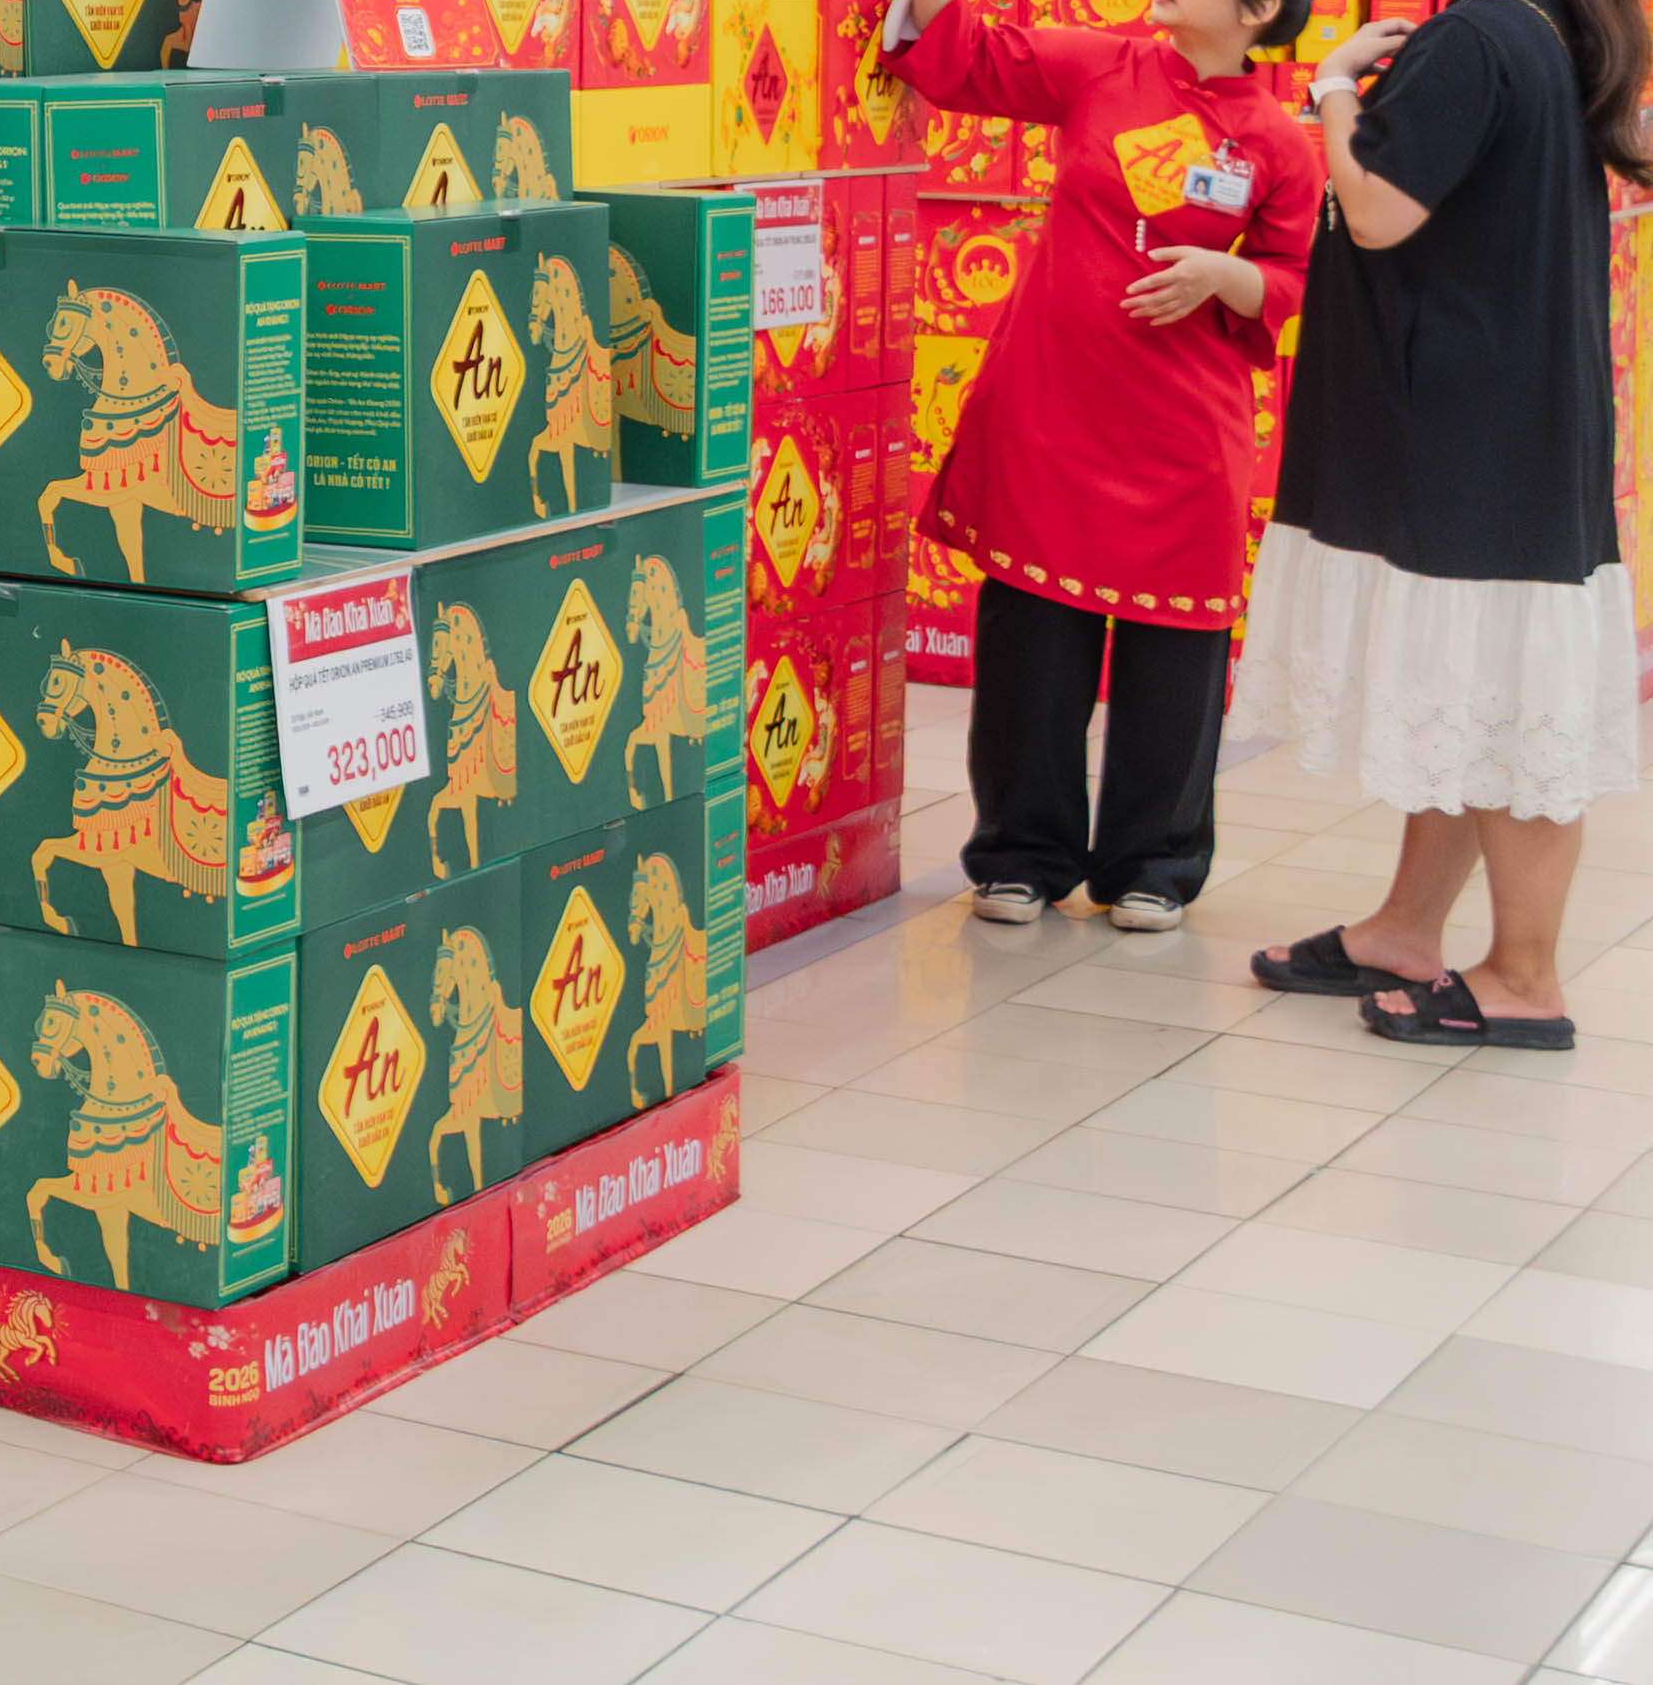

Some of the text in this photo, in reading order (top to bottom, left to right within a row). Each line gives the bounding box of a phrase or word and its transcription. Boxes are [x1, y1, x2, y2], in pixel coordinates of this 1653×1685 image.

[762, 285, 814, 317] 166,100
[453, 320, 507, 410] An
[328, 724, 416, 786] 323,000
[551, 934, 606, 1026] An
[264, 1276, 415, 1393] Mã Đáo Khai Xuân
[210, 1365, 259, 1393] 2026
